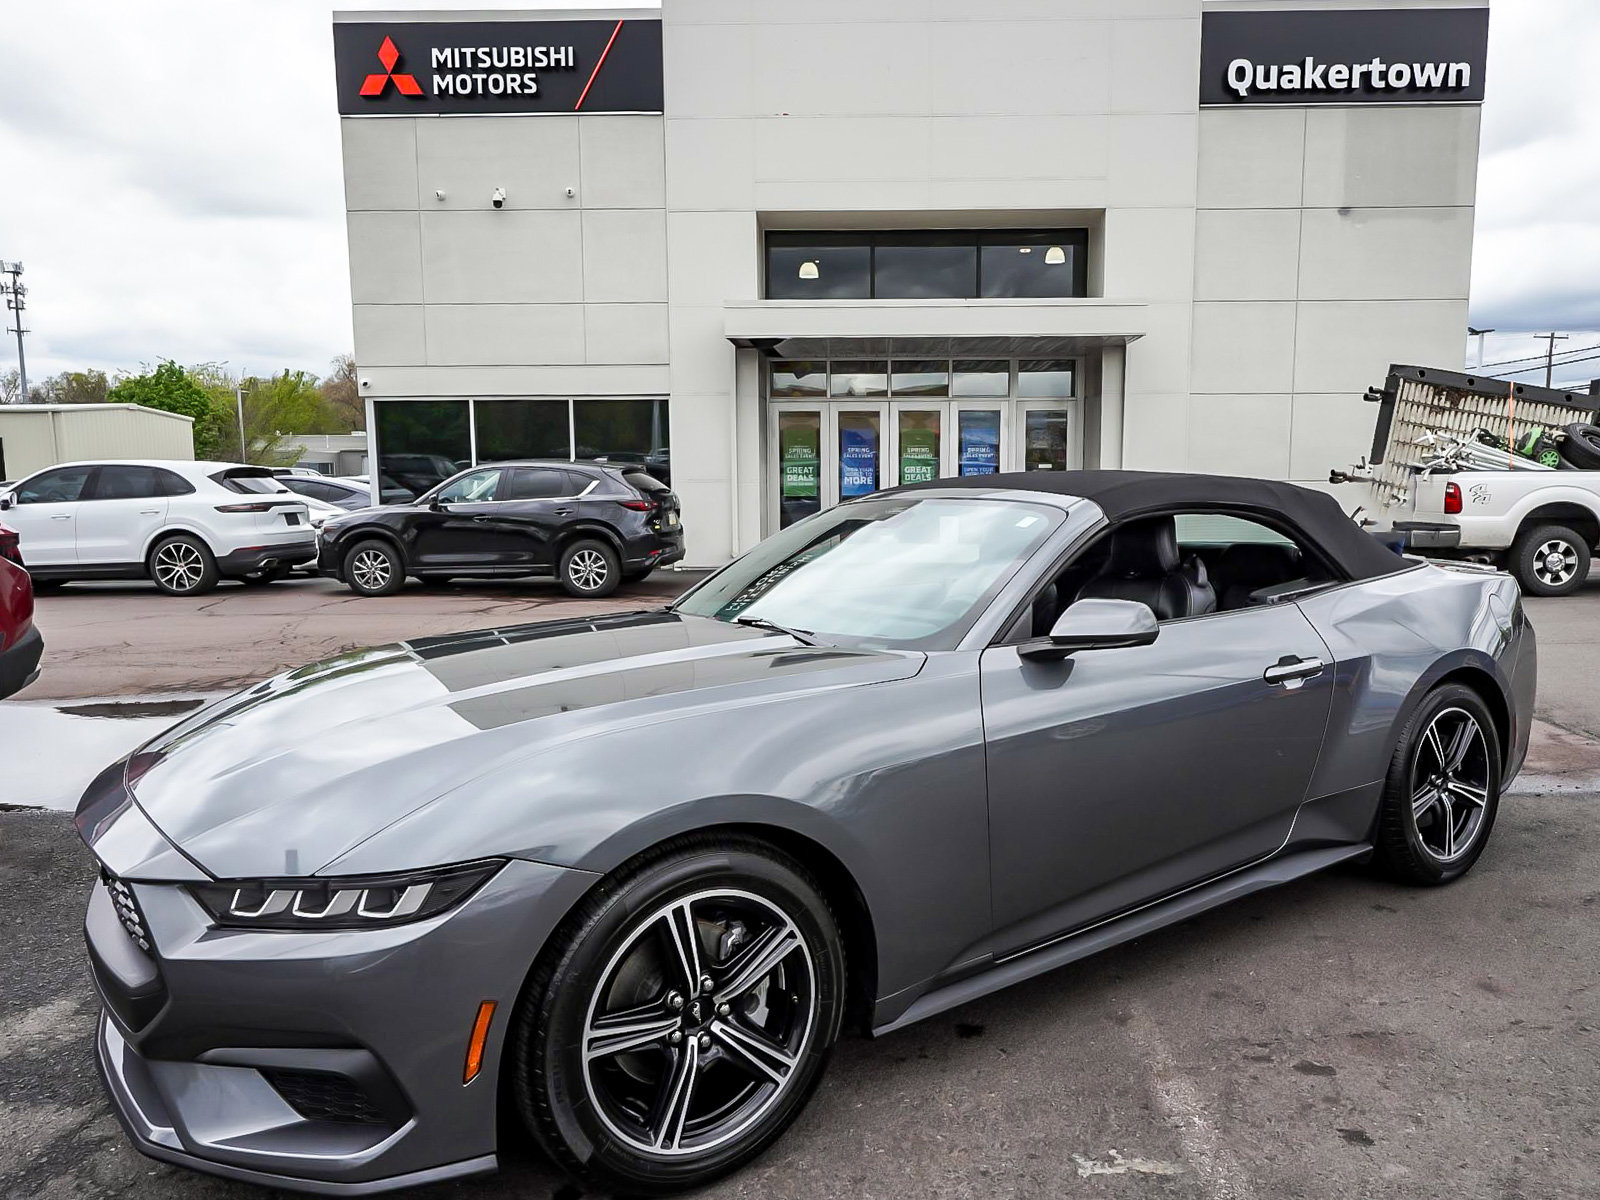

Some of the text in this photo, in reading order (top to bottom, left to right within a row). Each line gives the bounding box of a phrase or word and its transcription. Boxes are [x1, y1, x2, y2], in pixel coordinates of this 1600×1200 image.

[431, 46, 574, 69] MITSUBISHI
[432, 73, 538, 95] MOTORS
[1227, 56, 1471, 97] Quakertown
[844, 476, 872, 485] MORE
